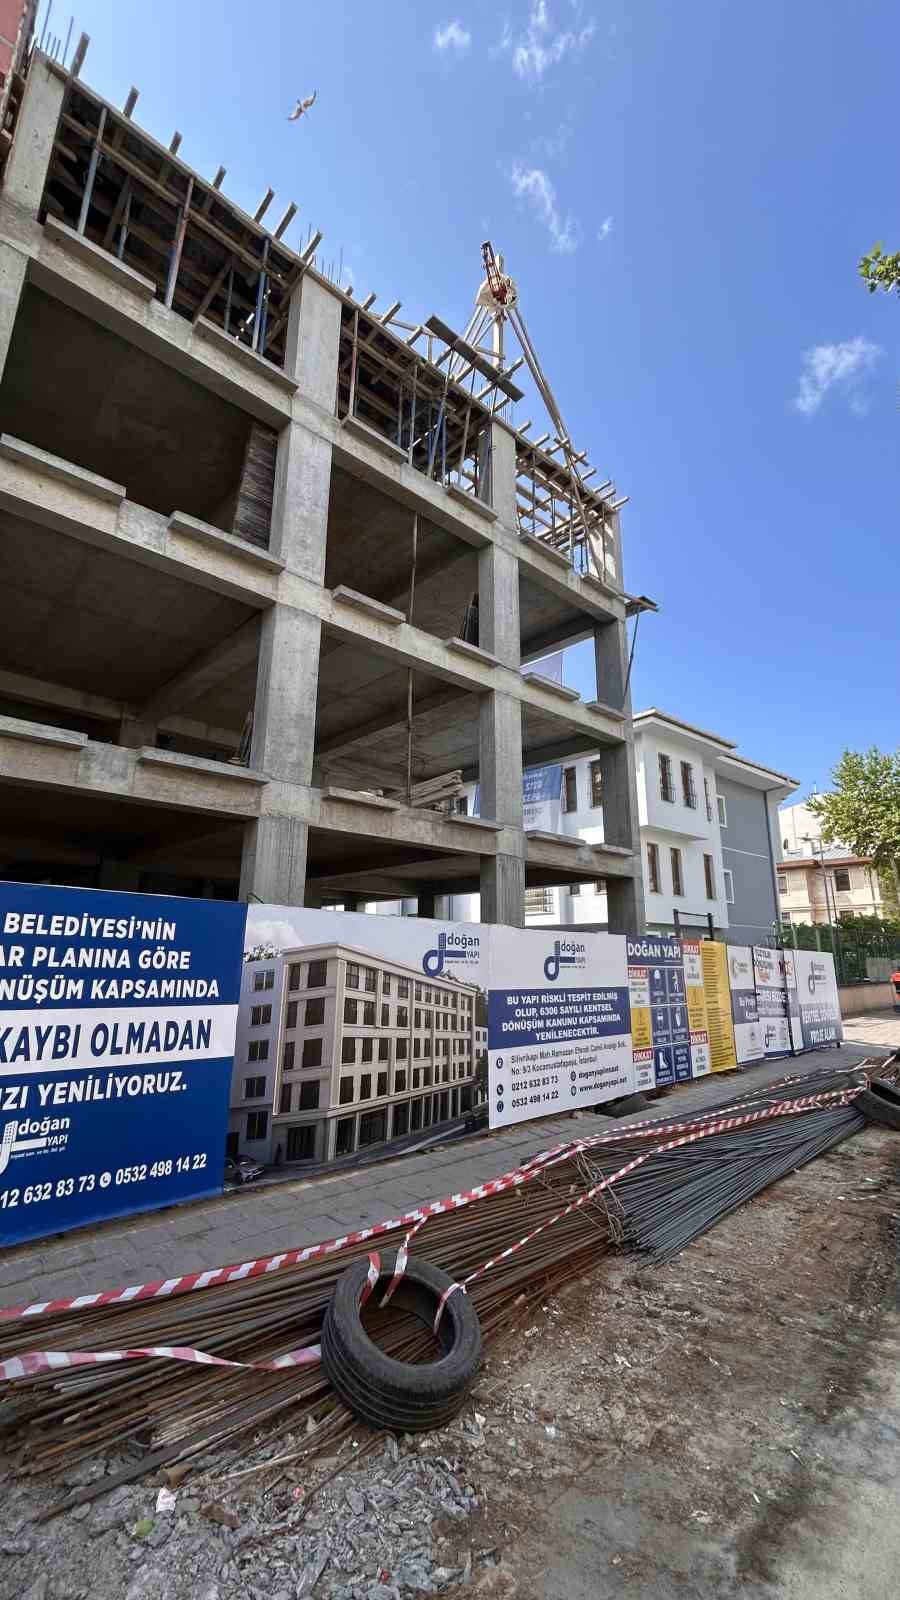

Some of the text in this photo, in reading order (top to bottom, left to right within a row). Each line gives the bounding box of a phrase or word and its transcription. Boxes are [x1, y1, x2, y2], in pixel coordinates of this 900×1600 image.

[4, 912, 177, 940] BELEDİYESİ'NİN
[447, 932, 480, 949] doğan
[627, 941, 681, 958] DOĞAN YAPI
[32, 946, 131, 968] PLANINA
[138, 947, 191, 970] GÖRE
[90, 979, 220, 1000] KAPSAMINDA
[507, 996, 519, 1005] BU
[521, 995, 539, 1004] YAPI
[541, 992, 566, 1003] RİSKLİ
[568, 992, 591, 1002] TESPİT
[560, 1005, 582, 1014] SAYILI
[584, 1003, 613, 1013] KENTSEL
[502, 1013, 621, 1032] DÖNÜŞÜM KANUNU KAPSAMINDA
[90, 1019, 213, 1057] OLMADAN
[38, 1071, 188, 1106] YENİLİYORUZ.
[551, 1075, 558, 1083] 73
[542, 1093, 550, 1101] 14
[551, 1091, 559, 1099] 22
[18, 1116, 71, 1136] doğan
[47, 1134, 69, 1146] YAPI
[23, 1182, 53, 1204] 632
[55, 1178, 75, 1197] 83
[78, 1174, 96, 1193] 73
[115, 1164, 148, 1186] 0532
[150, 1159, 173, 1179] 498
[176, 1156, 190, 1173] 14
[192, 1153, 207, 1170] 22
